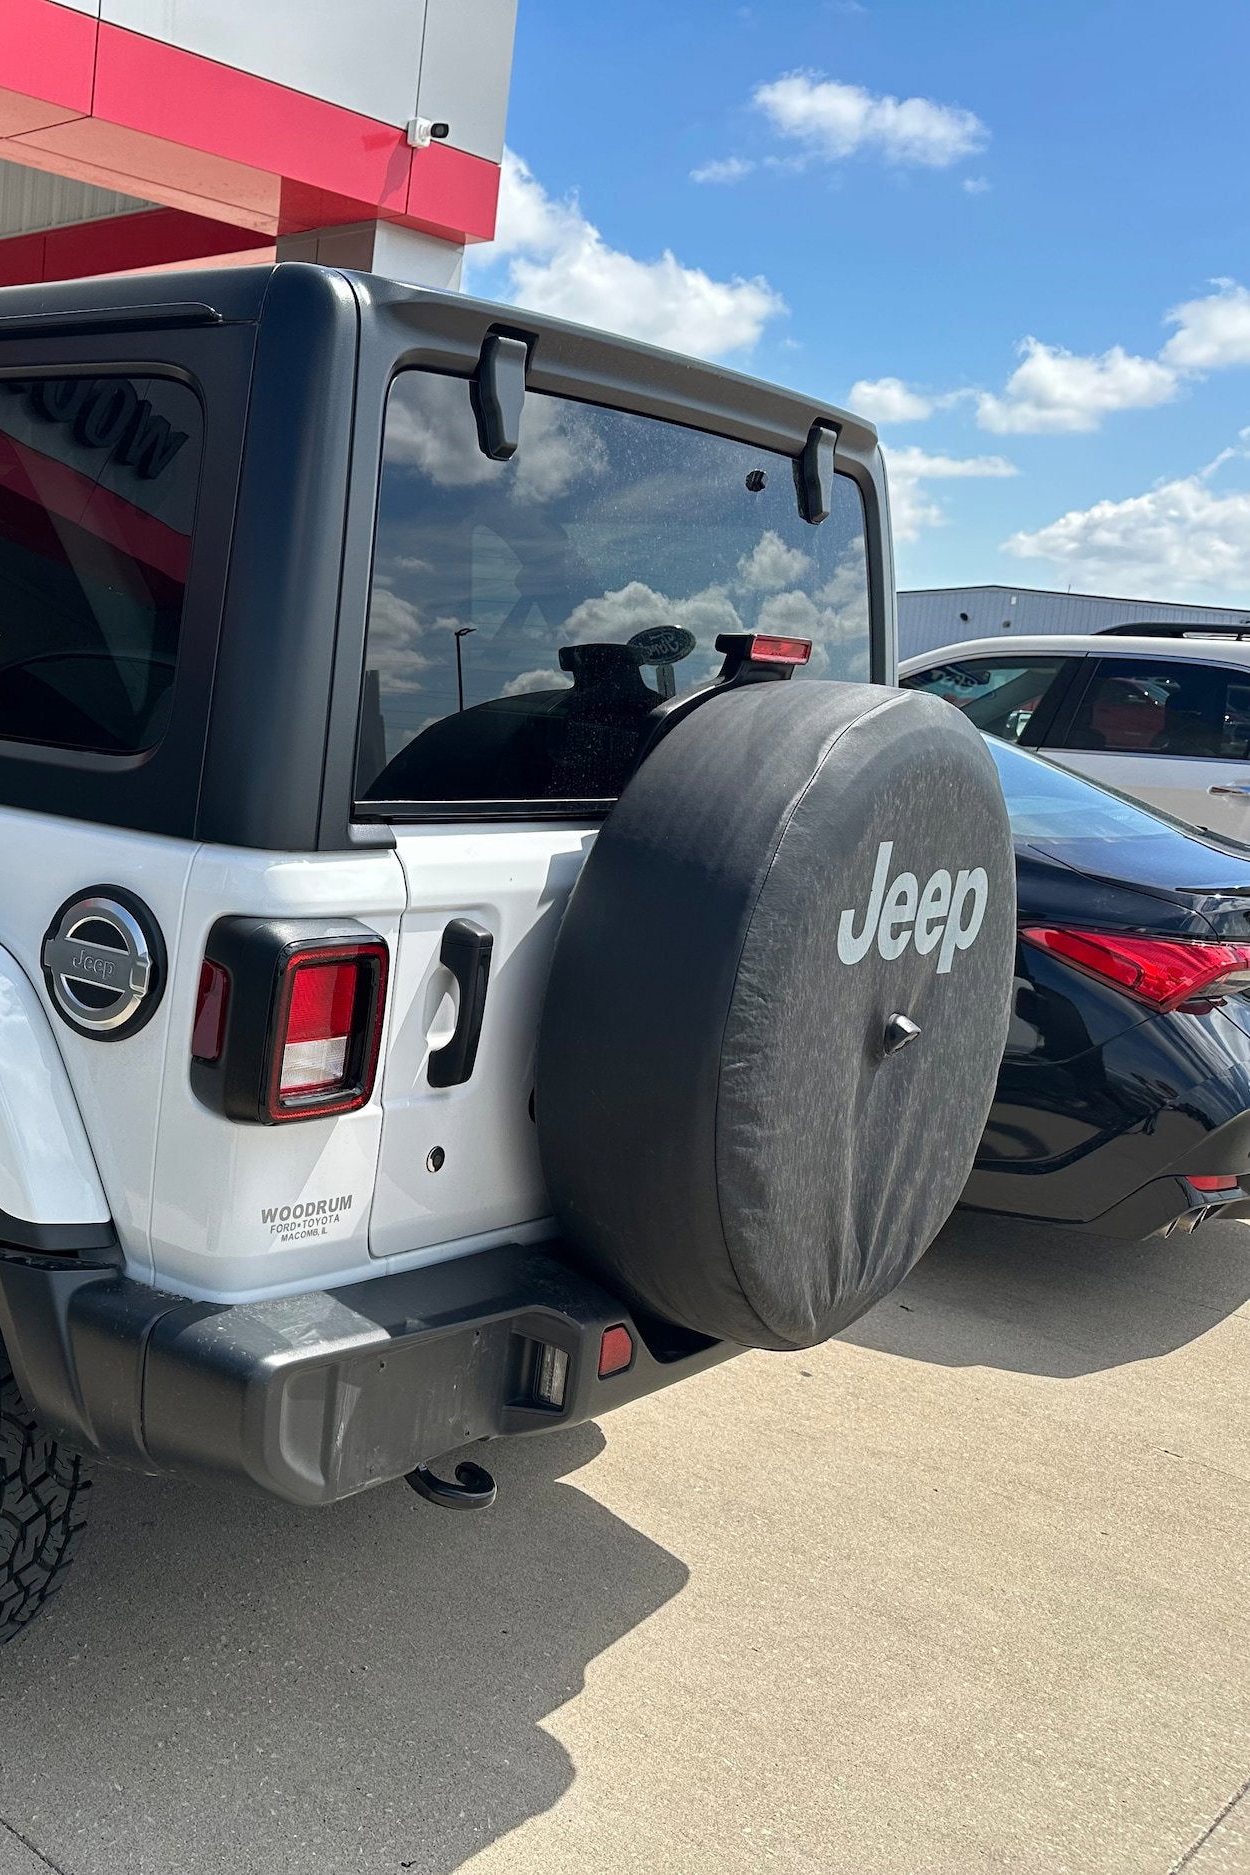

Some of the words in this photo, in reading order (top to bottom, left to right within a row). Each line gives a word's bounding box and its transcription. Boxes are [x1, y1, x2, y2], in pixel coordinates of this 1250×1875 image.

[837, 841, 989, 974] Jeep
[72, 950, 115, 980] Jeep
[261, 1195, 352, 1224] WOODRUM
